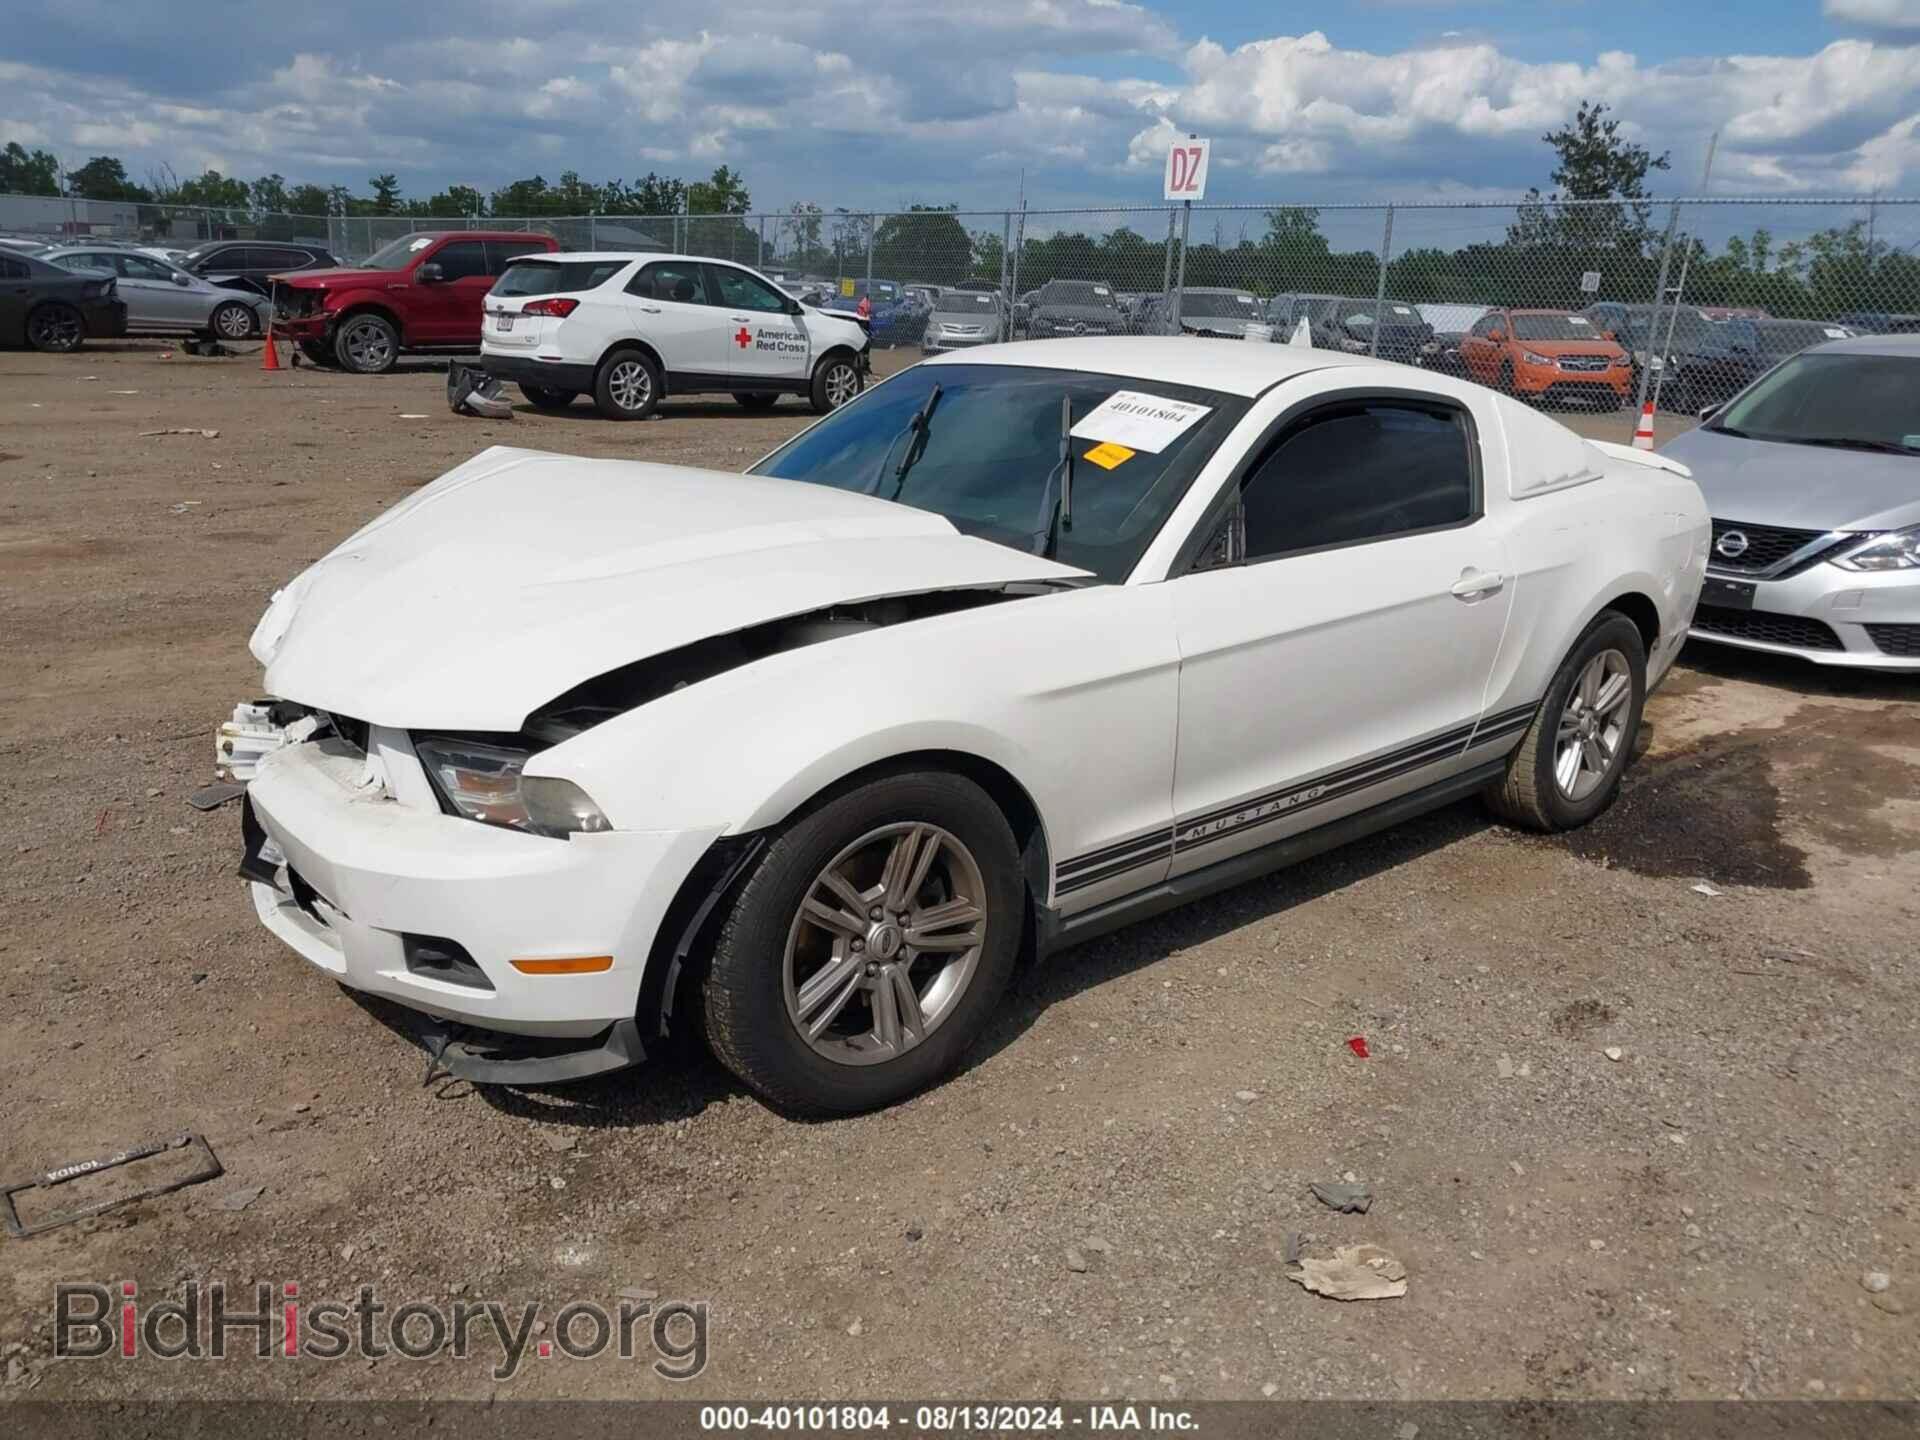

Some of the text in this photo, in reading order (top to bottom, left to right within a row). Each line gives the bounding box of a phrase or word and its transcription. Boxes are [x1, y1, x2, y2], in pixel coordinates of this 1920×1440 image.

[1170, 147, 1202, 192] DZ
[757, 328, 806, 341] American
[756, 341, 806, 353] Red Cross
[1110, 401, 1186, 423] 40101804
[1191, 788, 1320, 838] MUSTANG
